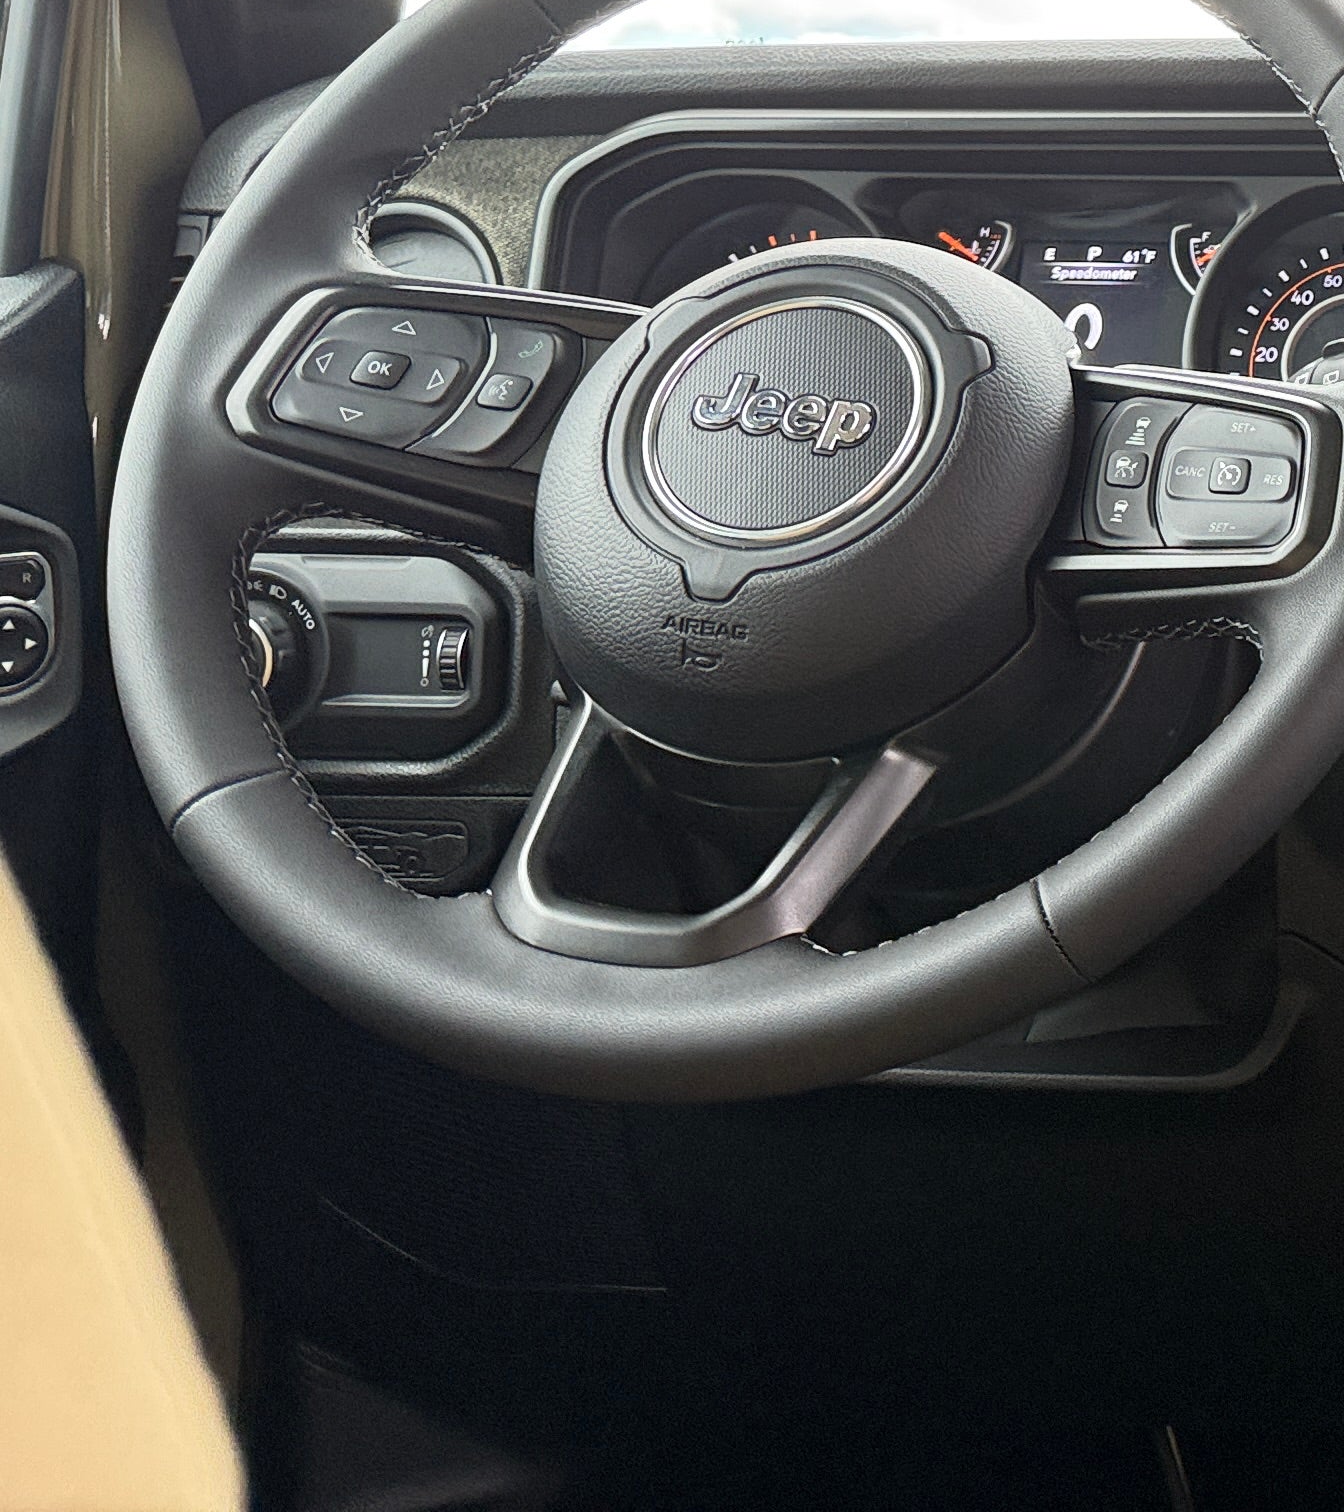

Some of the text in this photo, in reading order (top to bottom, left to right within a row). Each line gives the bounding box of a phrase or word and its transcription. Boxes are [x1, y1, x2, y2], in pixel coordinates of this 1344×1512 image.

[1201, 231, 1211, 242] F
[1043, 247, 1057, 261] E
[1087, 246, 1102, 261] P
[1050, 266, 1138, 281] Speedometer
[1323, 274, 1343, 288] 50
[1290, 289, 1314, 306] 40
[1270, 317, 1290, 331] 30
[1254, 346, 1278, 363] 20
[367, 361, 392, 376] OK
[692, 372, 877, 456] Jeep
[1174, 464, 1206, 478] CANC
[1263, 474, 1284, 486] RES
[22, 572, 32, 583] R
[291, 598, 316, 630] AUTO
[662, 615, 749, 639] AIRBAG
